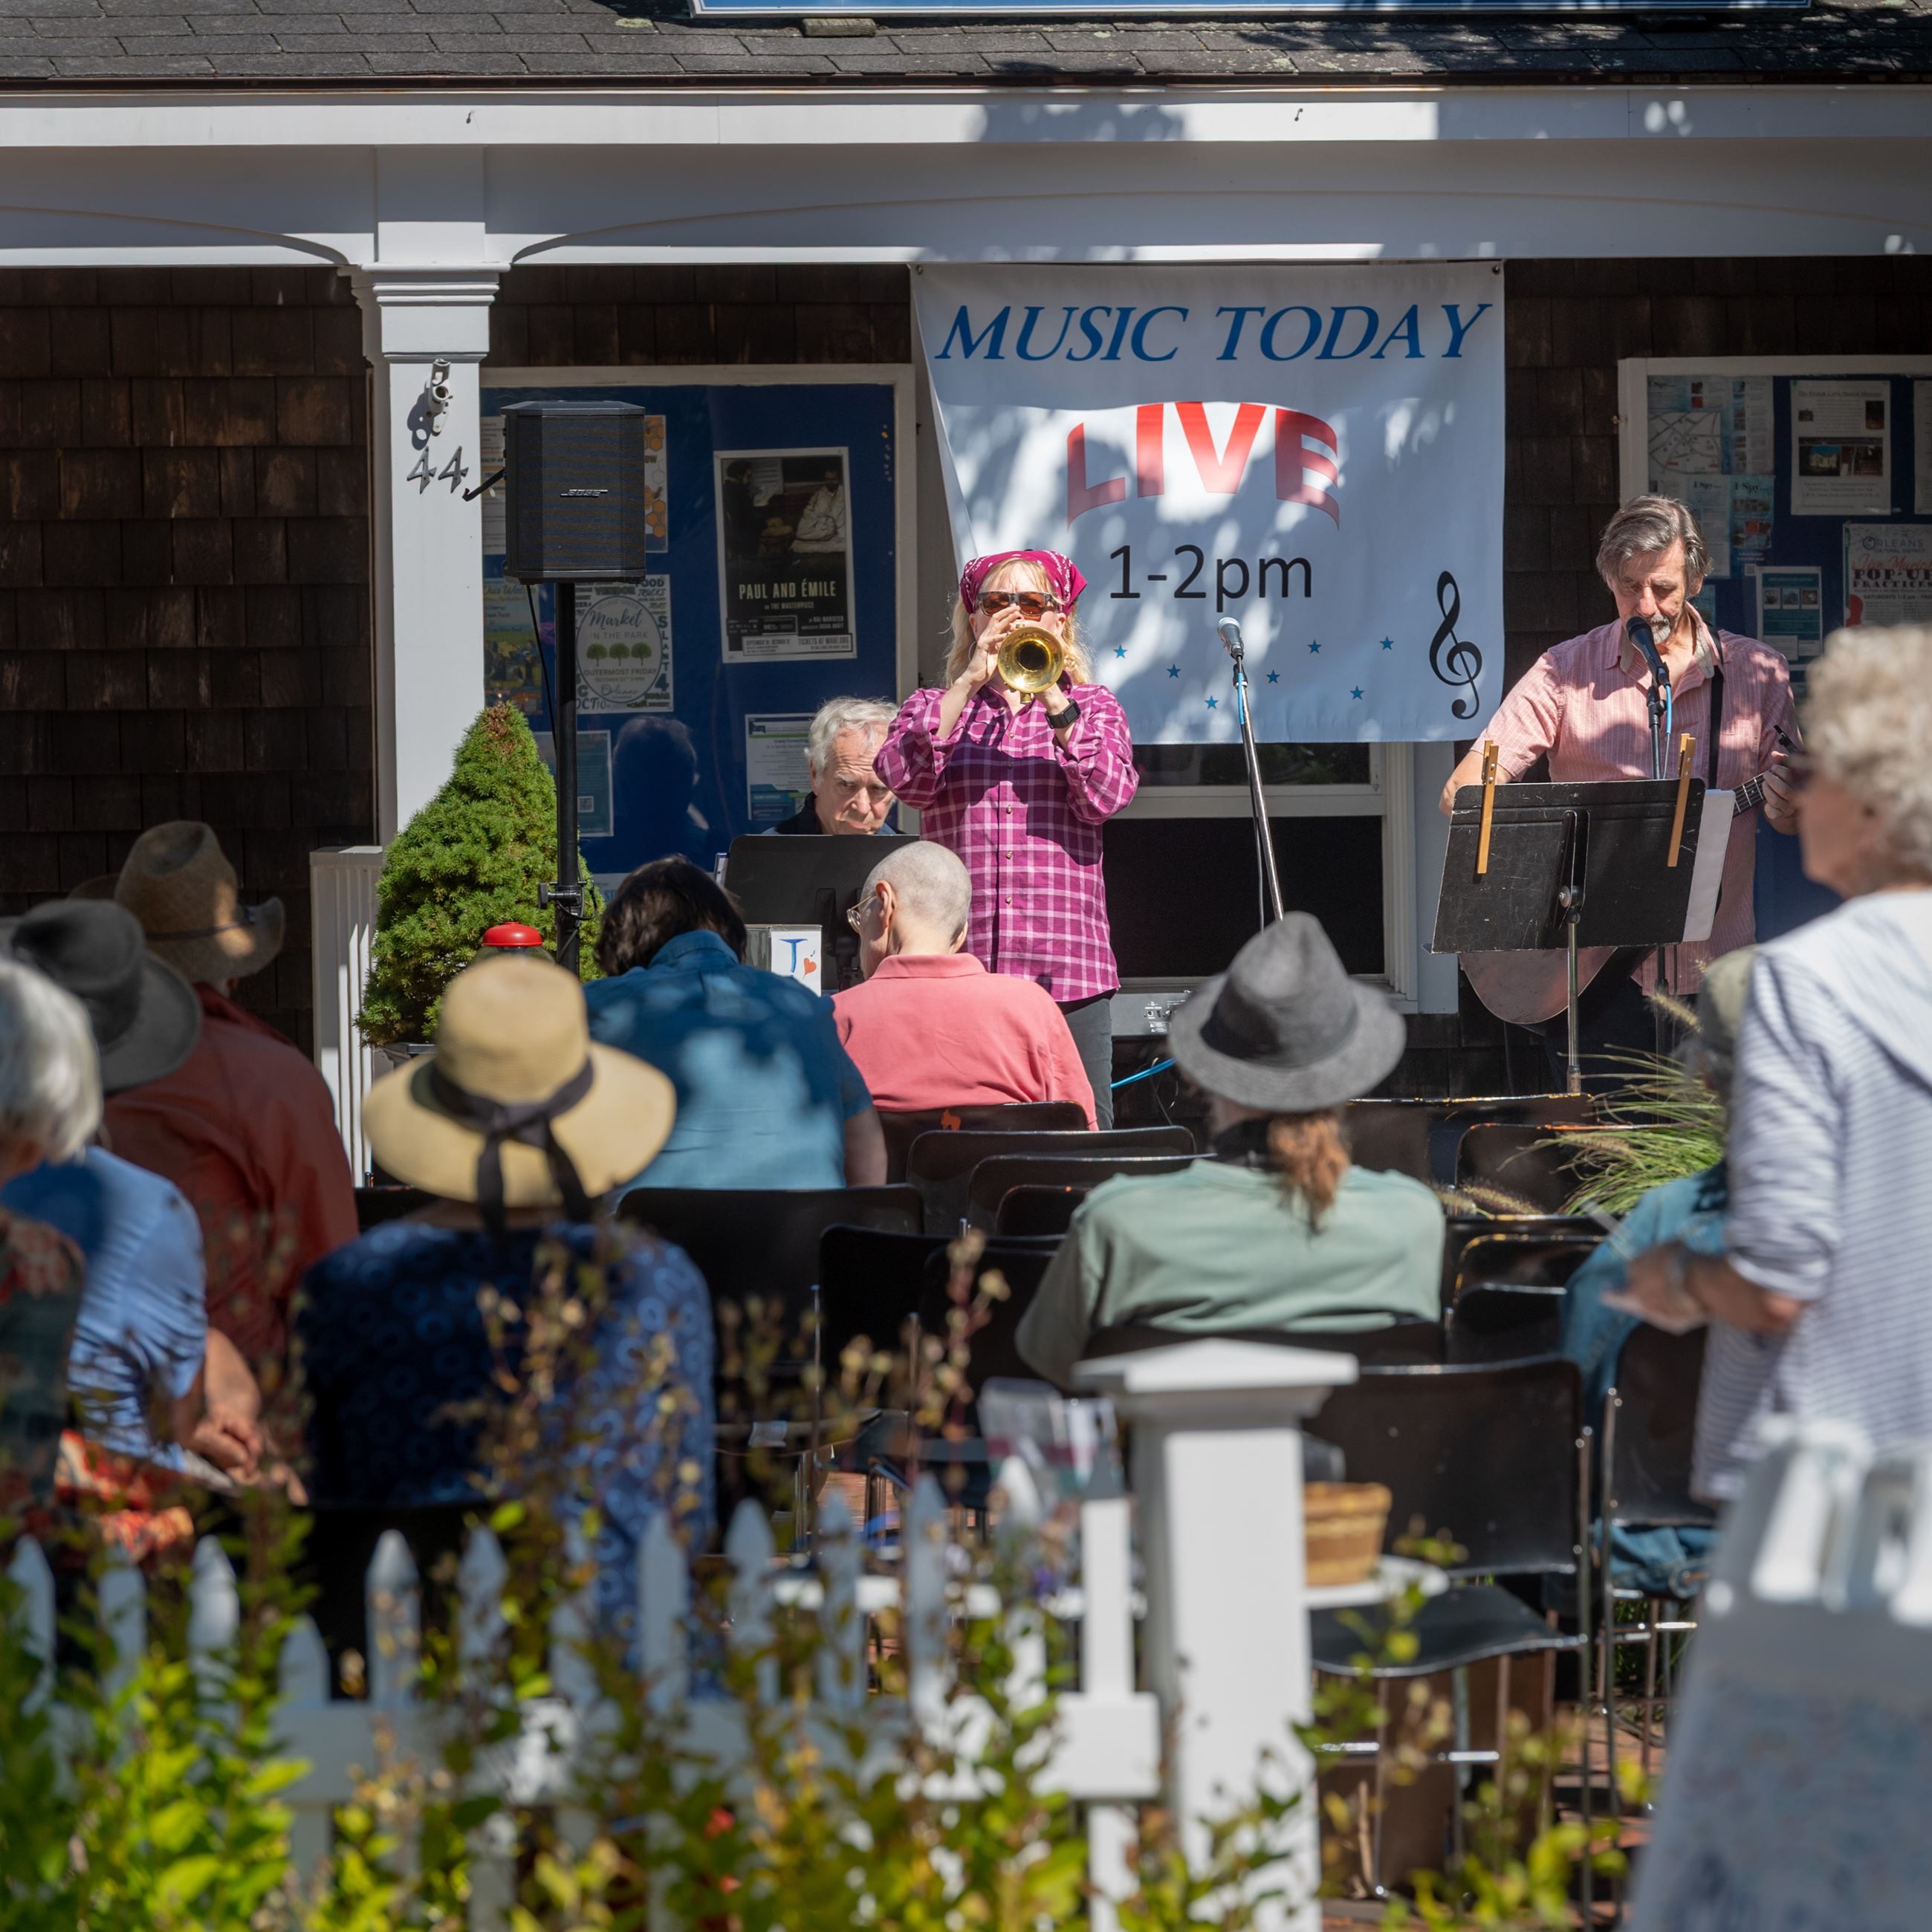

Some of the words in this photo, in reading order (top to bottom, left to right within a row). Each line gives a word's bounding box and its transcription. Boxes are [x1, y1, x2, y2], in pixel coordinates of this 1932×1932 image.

[935, 305, 1188, 361] MUSIC
[1215, 303, 1493, 361] TODAY
[406, 445, 470, 495] 44
[1067, 401, 1340, 531] LIVE
[1862, 536, 1924, 551] ORLEANS
[636, 579, 665, 588] OOD
[1109, 544, 1312, 612] 1-2pm
[739, 583, 768, 600] PAUL
[773, 582, 797, 598] AND
[801, 578, 837, 597] ÉMILE
[589, 609, 643, 630] Market
[624, 631, 648, 639] PARK
[583, 668, 629, 676] OUTERMOST
